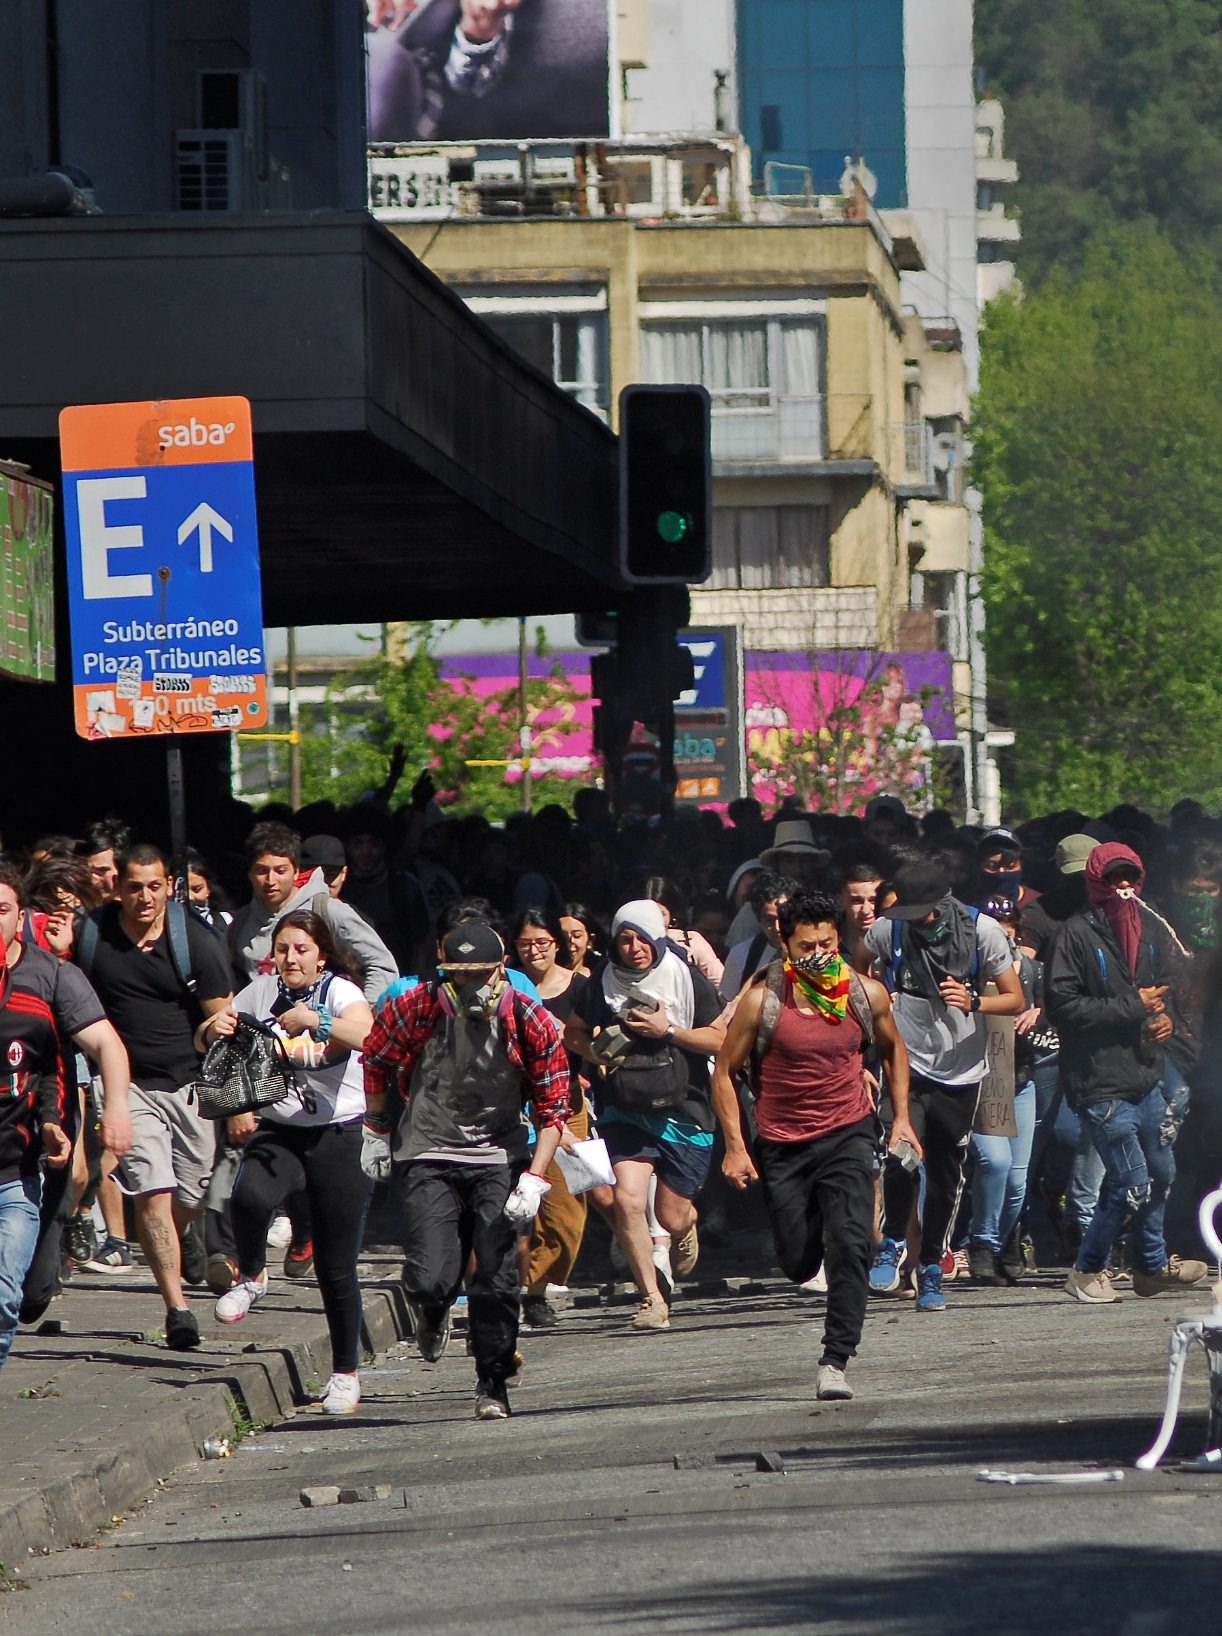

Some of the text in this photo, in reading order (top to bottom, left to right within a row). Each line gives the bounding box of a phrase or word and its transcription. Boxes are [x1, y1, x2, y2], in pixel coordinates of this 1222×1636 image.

[158, 417, 226, 448] saba
[76, 475, 153, 600] E
[103, 617, 239, 644] Subterráneo
[83, 645, 262, 675] Plaza Tribunales
[176, 693, 217, 715] mts
